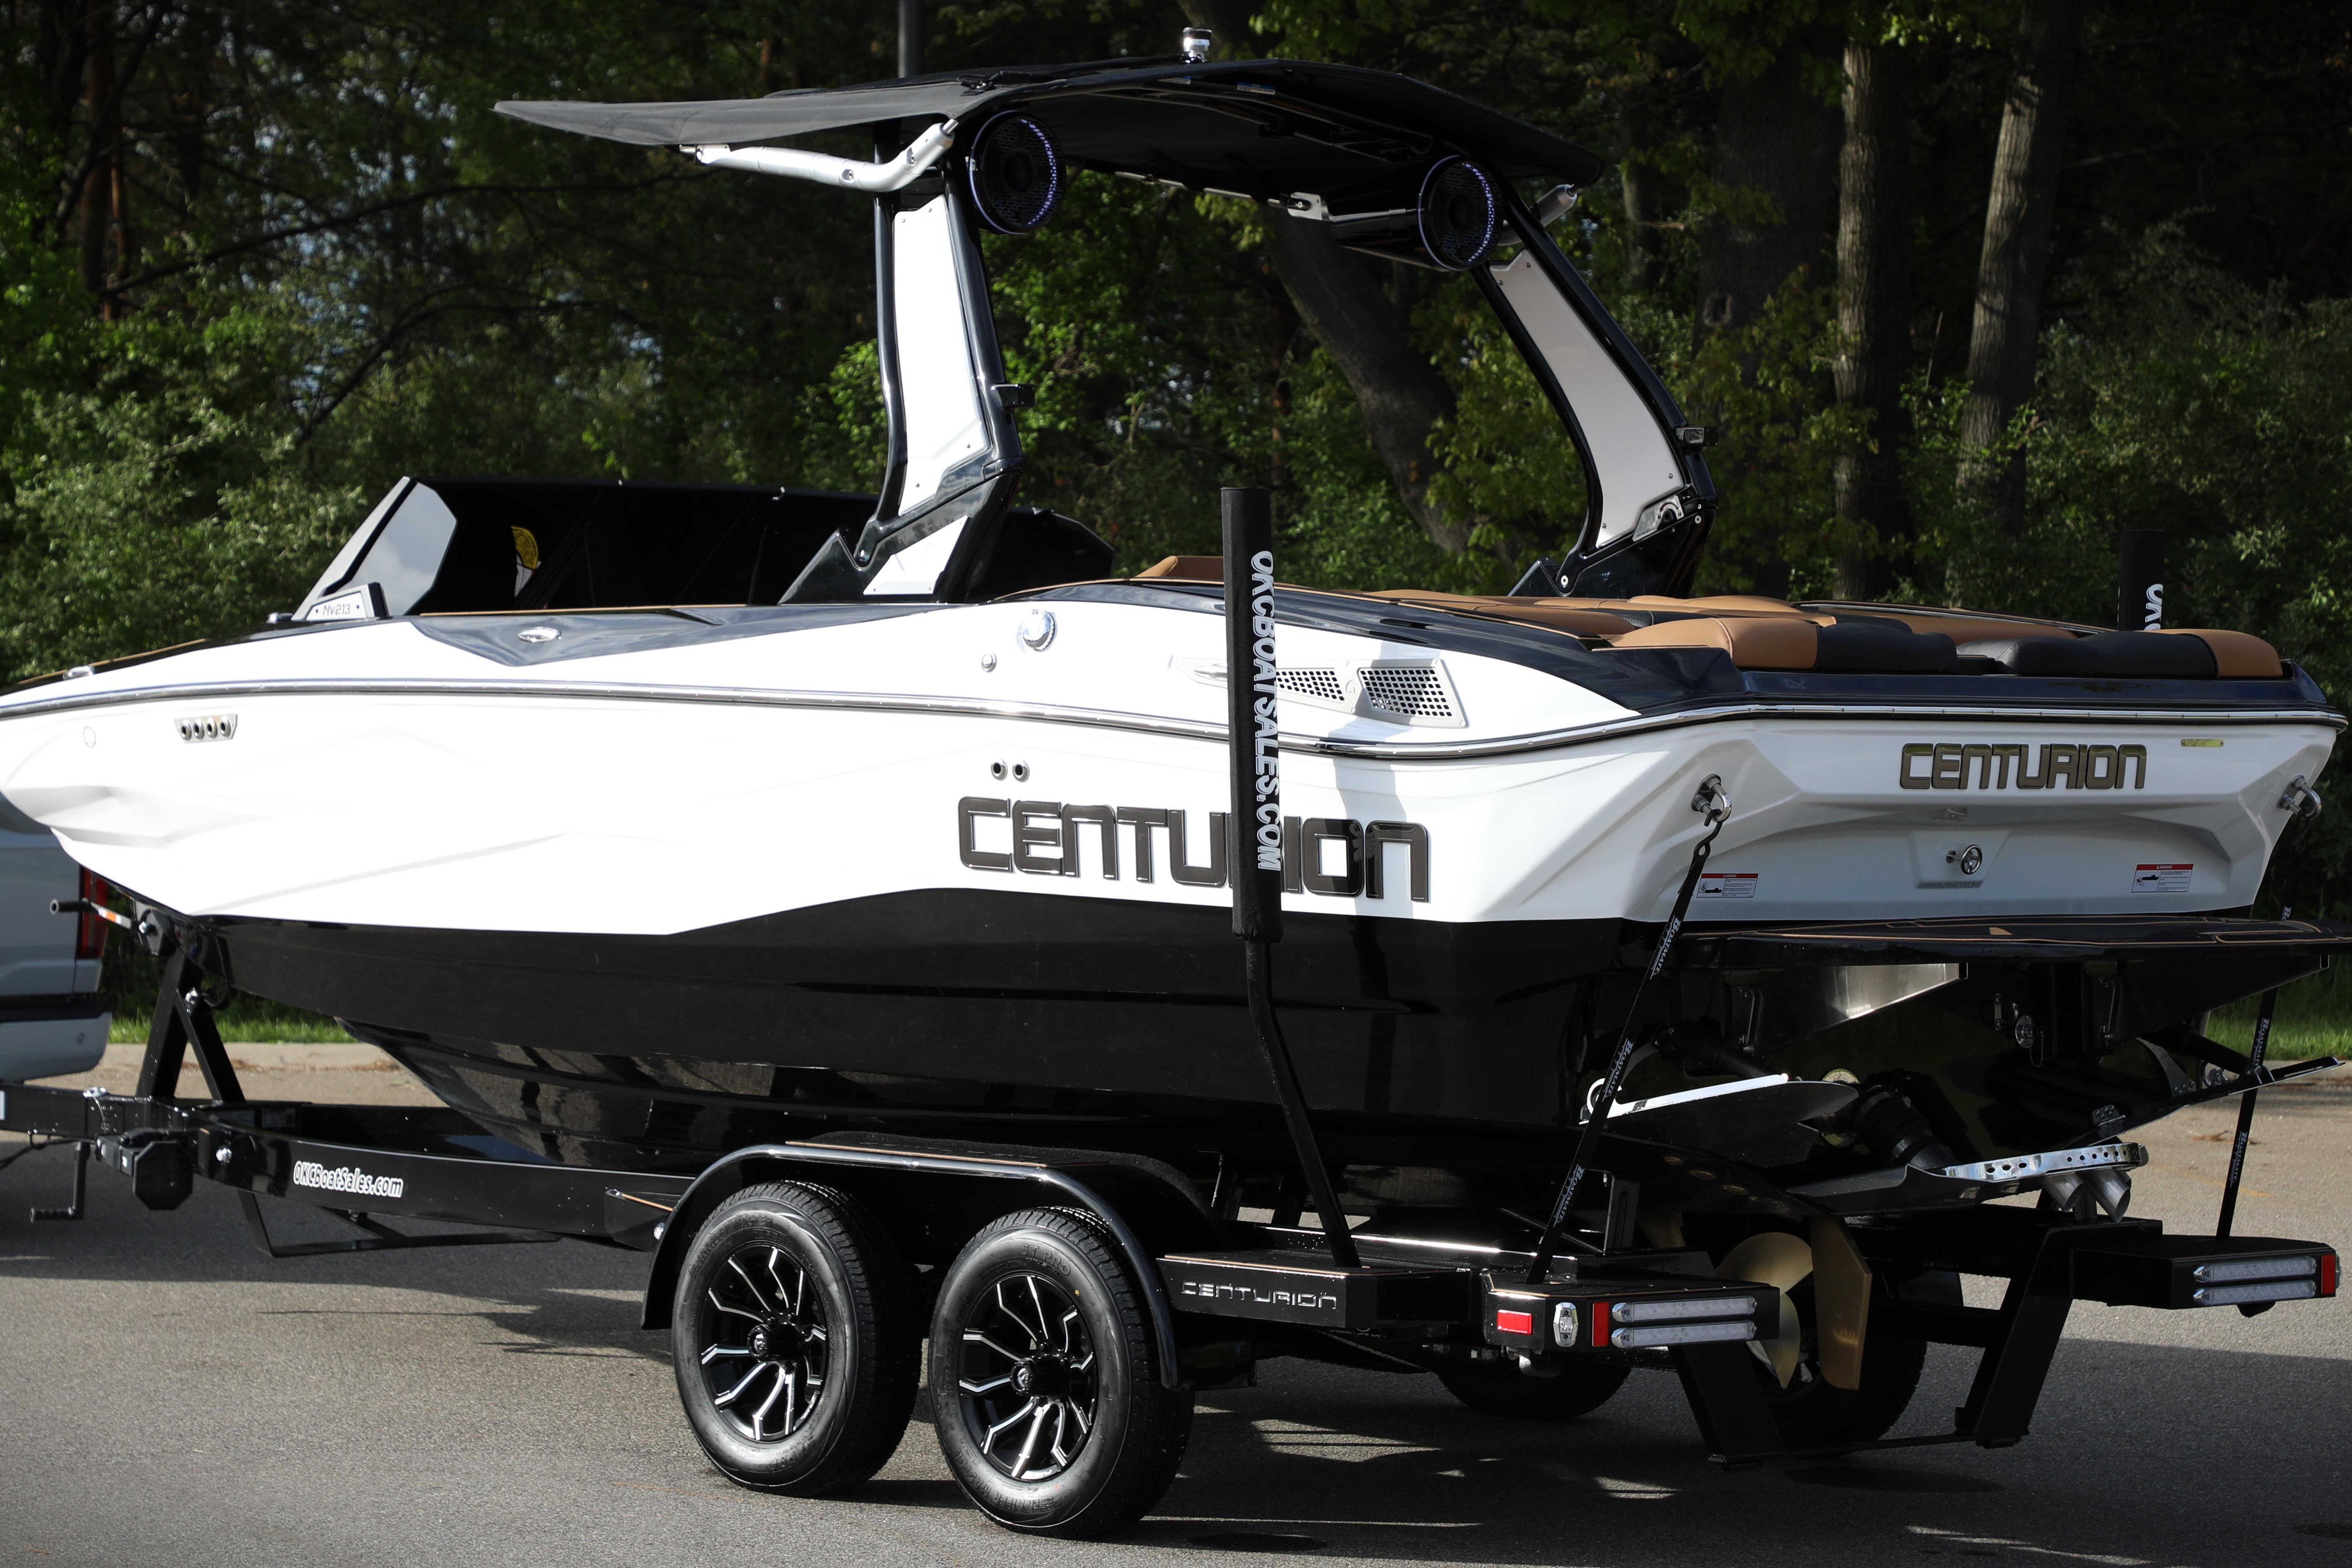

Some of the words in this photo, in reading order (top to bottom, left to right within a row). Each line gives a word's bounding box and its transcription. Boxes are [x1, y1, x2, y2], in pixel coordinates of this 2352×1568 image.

[2145, 584, 2163, 631] OK
[1251, 551, 1281, 871] OKCBOATSALES.COM
[1899, 743, 2147, 789] CENTURION
[958, 796, 1429, 902] CENTUION
[293, 1161, 404, 1198] OKCBoatSales.com
[1181, 1281, 1337, 1309] CENTURION
